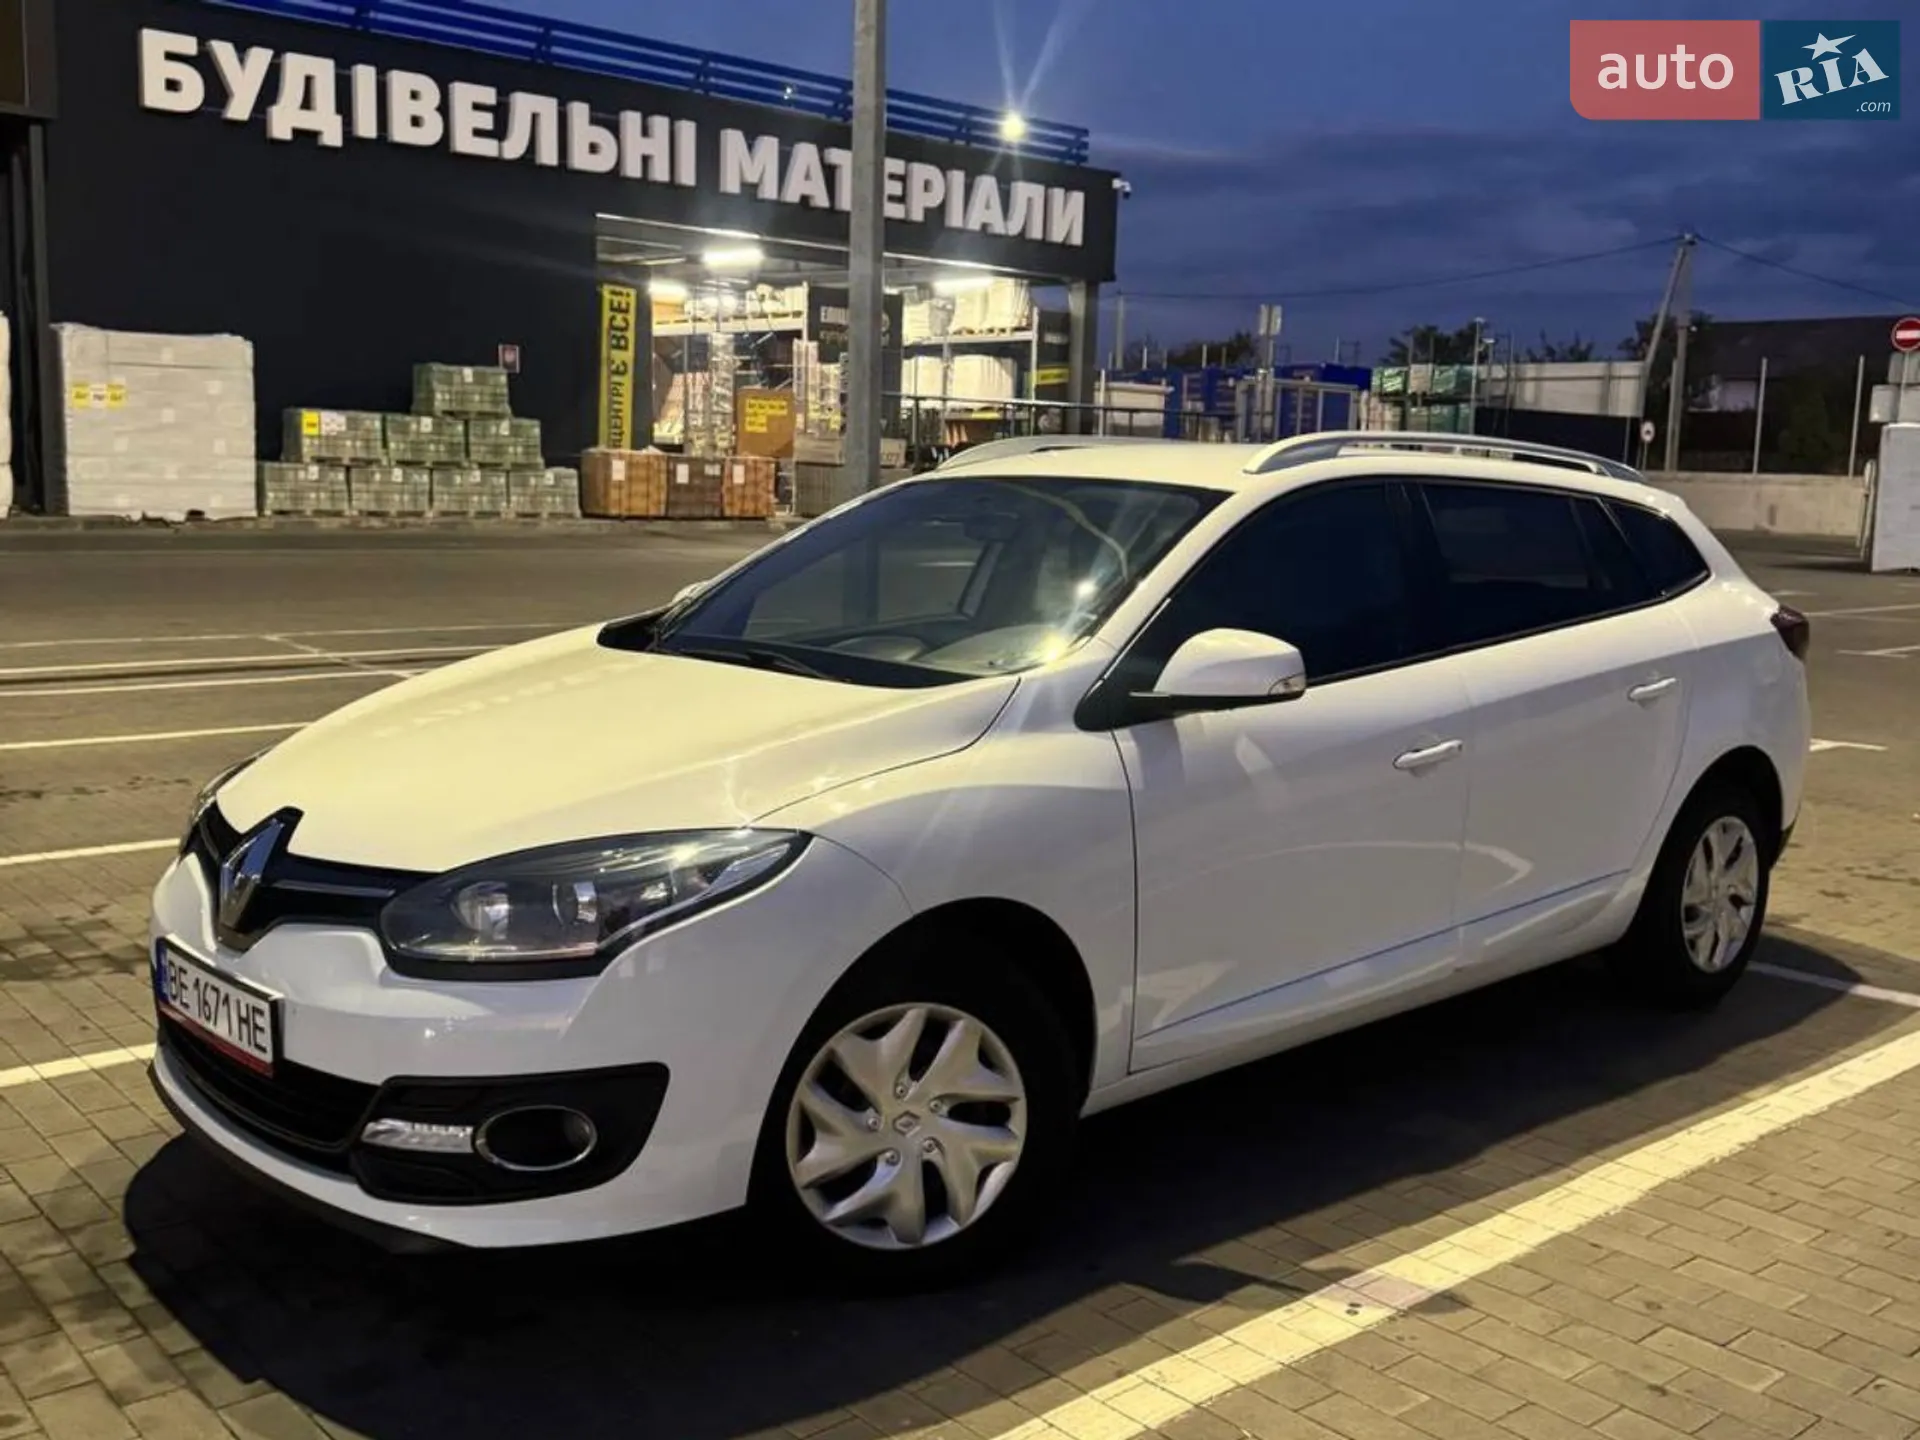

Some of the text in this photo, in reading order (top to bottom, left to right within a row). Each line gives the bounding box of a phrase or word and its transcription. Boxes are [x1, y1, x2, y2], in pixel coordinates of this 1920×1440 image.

[138, 28, 1085, 247] БУДІВЕЛЬНІ МАТЕРІАЛИ
[609, 289, 631, 351] ВСЕ!
[168, 959, 268, 1054] BE 1671 HE
